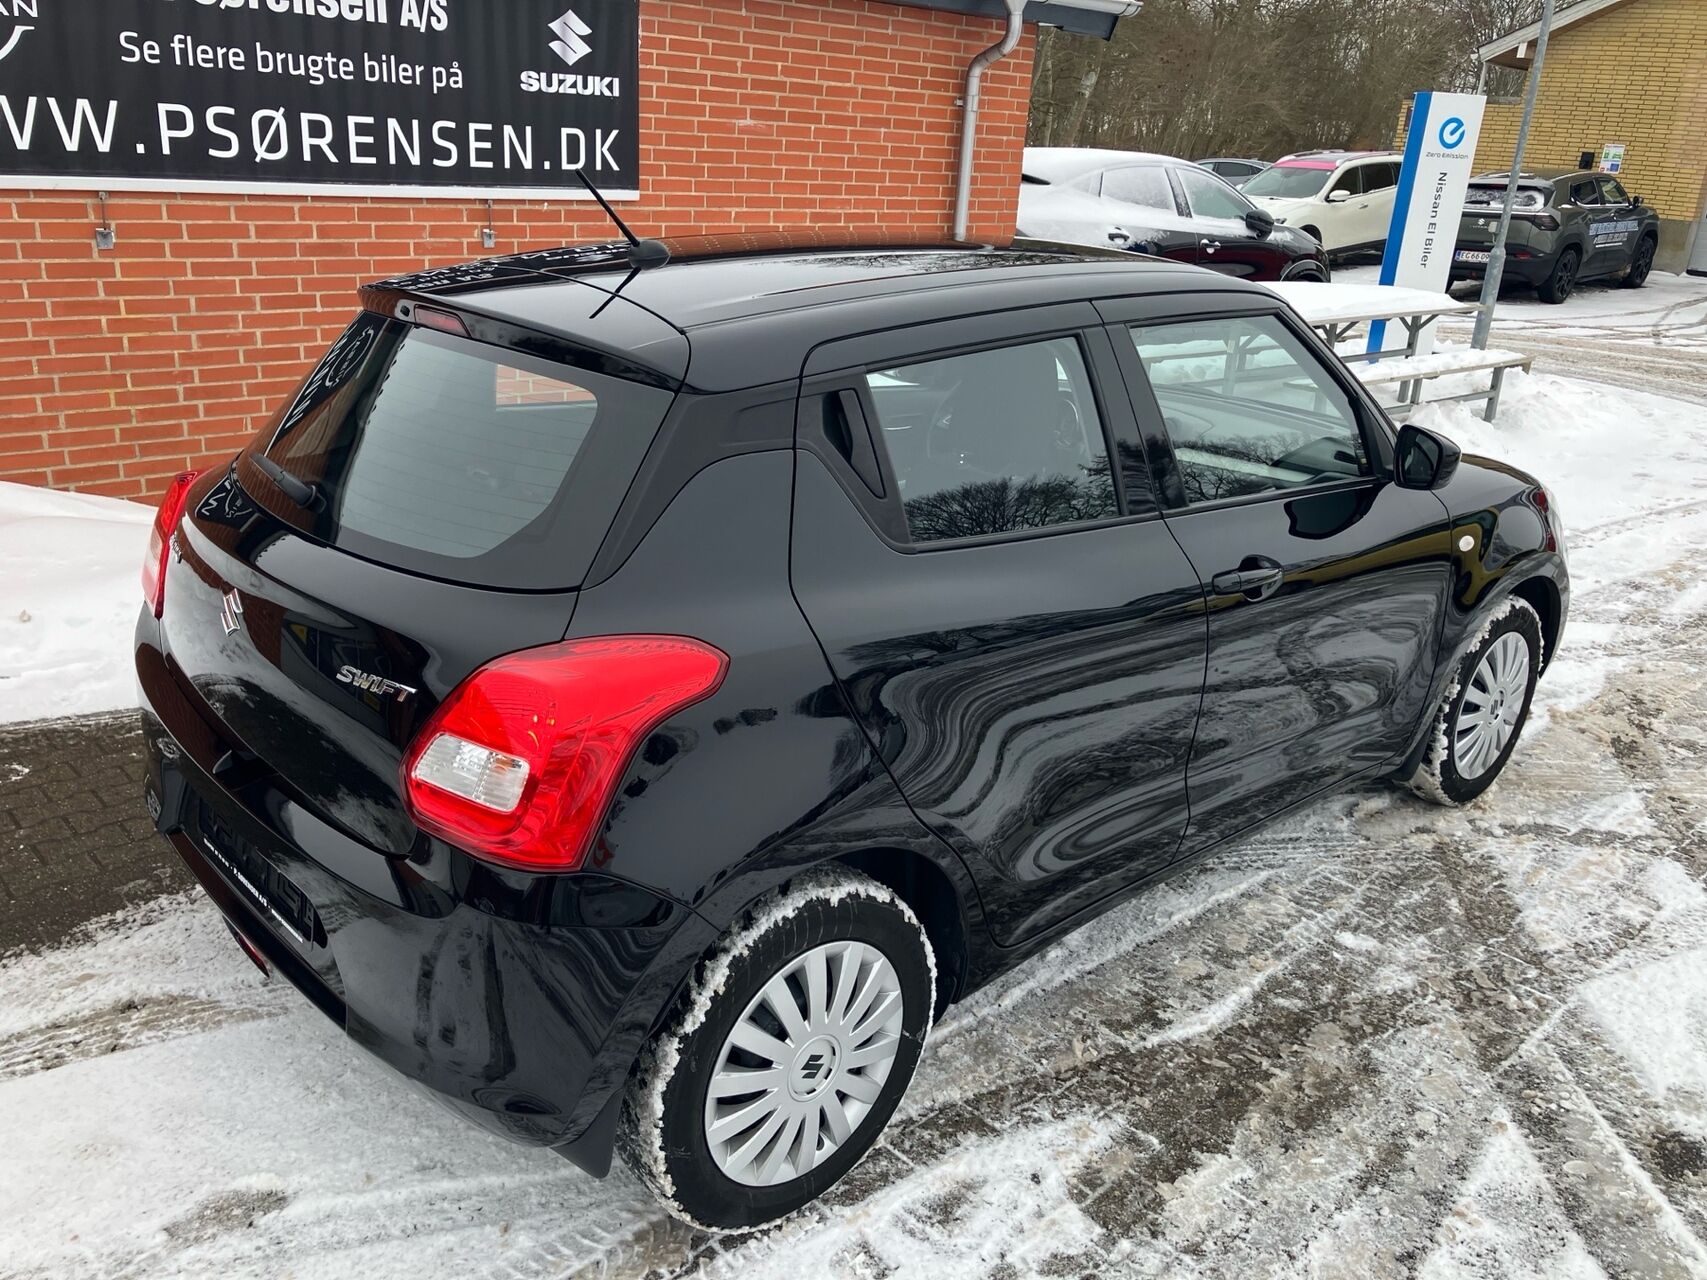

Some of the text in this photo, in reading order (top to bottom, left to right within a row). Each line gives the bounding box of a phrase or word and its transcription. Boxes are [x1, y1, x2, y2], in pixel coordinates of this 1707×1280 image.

[400, 0, 449, 33] A/S
[119, 30, 464, 94] Se flere brugte biler på
[520, 70, 620, 98] SUZUKI
[1425, 151, 1469, 161] Zero Emission
[1420, 171, 1448, 269] Nissan El Biler
[336, 665, 417, 703] SWIFT
